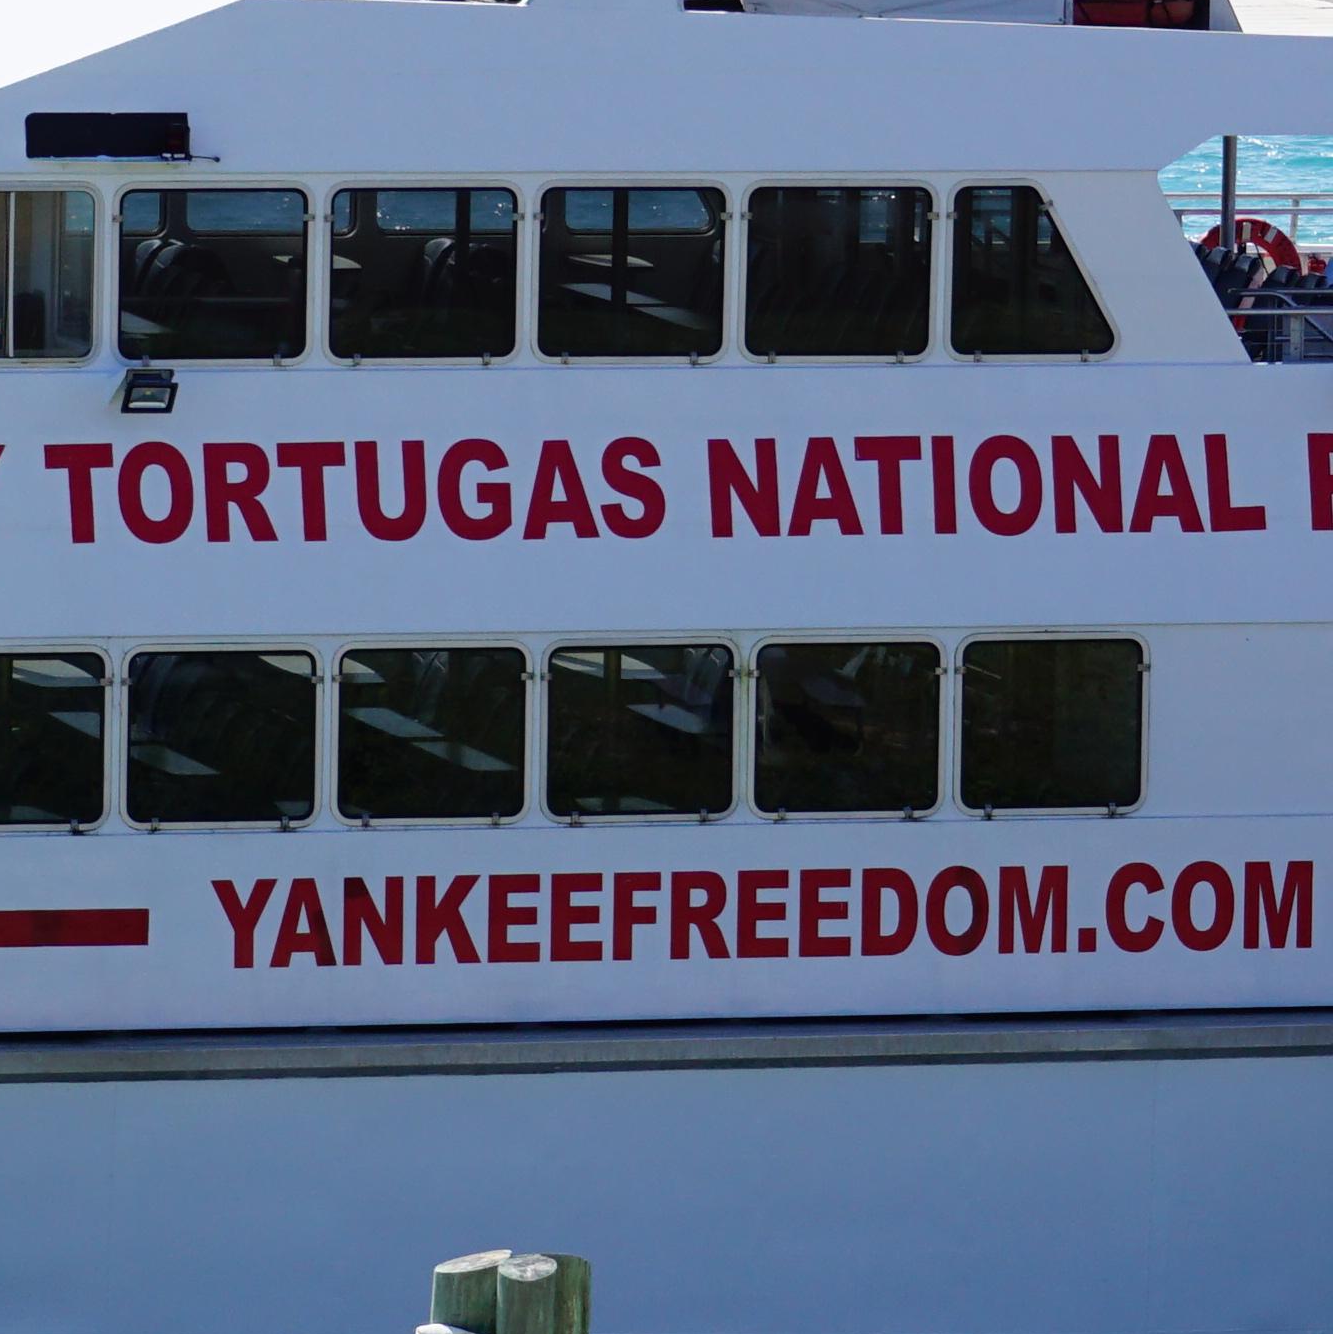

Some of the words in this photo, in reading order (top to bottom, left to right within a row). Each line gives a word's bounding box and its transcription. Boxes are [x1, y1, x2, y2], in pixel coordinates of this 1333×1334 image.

[44, 437, 666, 544] TORTUGAS
[708, 433, 1267, 537] NATIONAL
[212, 860, 1314, 969] YANKEEFREEDOM.COM
